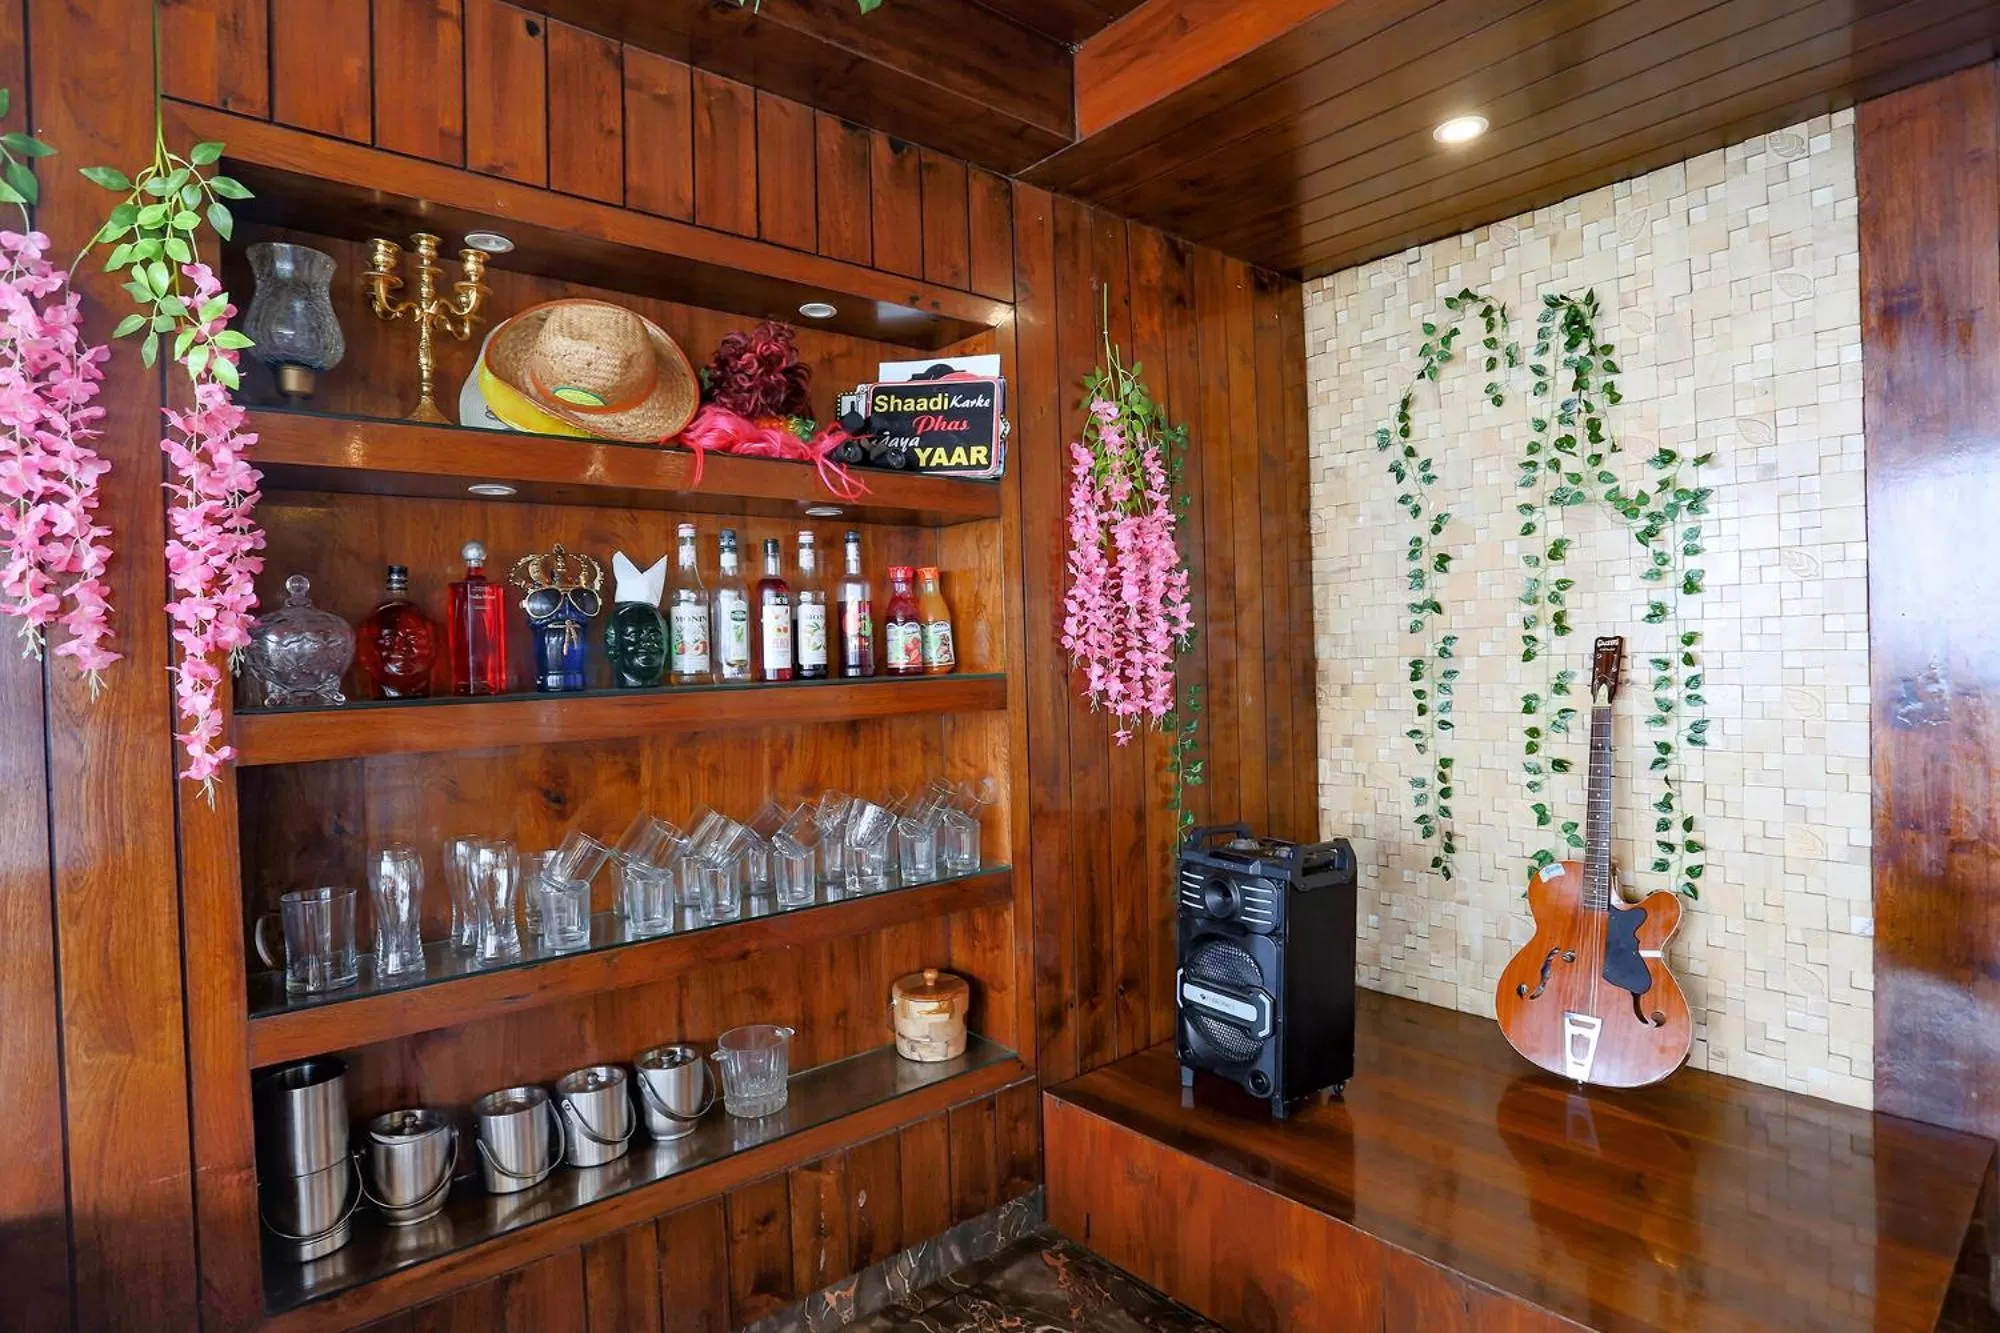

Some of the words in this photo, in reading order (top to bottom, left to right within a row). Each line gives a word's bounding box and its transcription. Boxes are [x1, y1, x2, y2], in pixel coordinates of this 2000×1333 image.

[874, 393, 949, 413] Shaadi
[950, 394, 991, 409] Karke
[912, 415, 970, 435] Phas
[914, 446, 989, 467] YAAR
